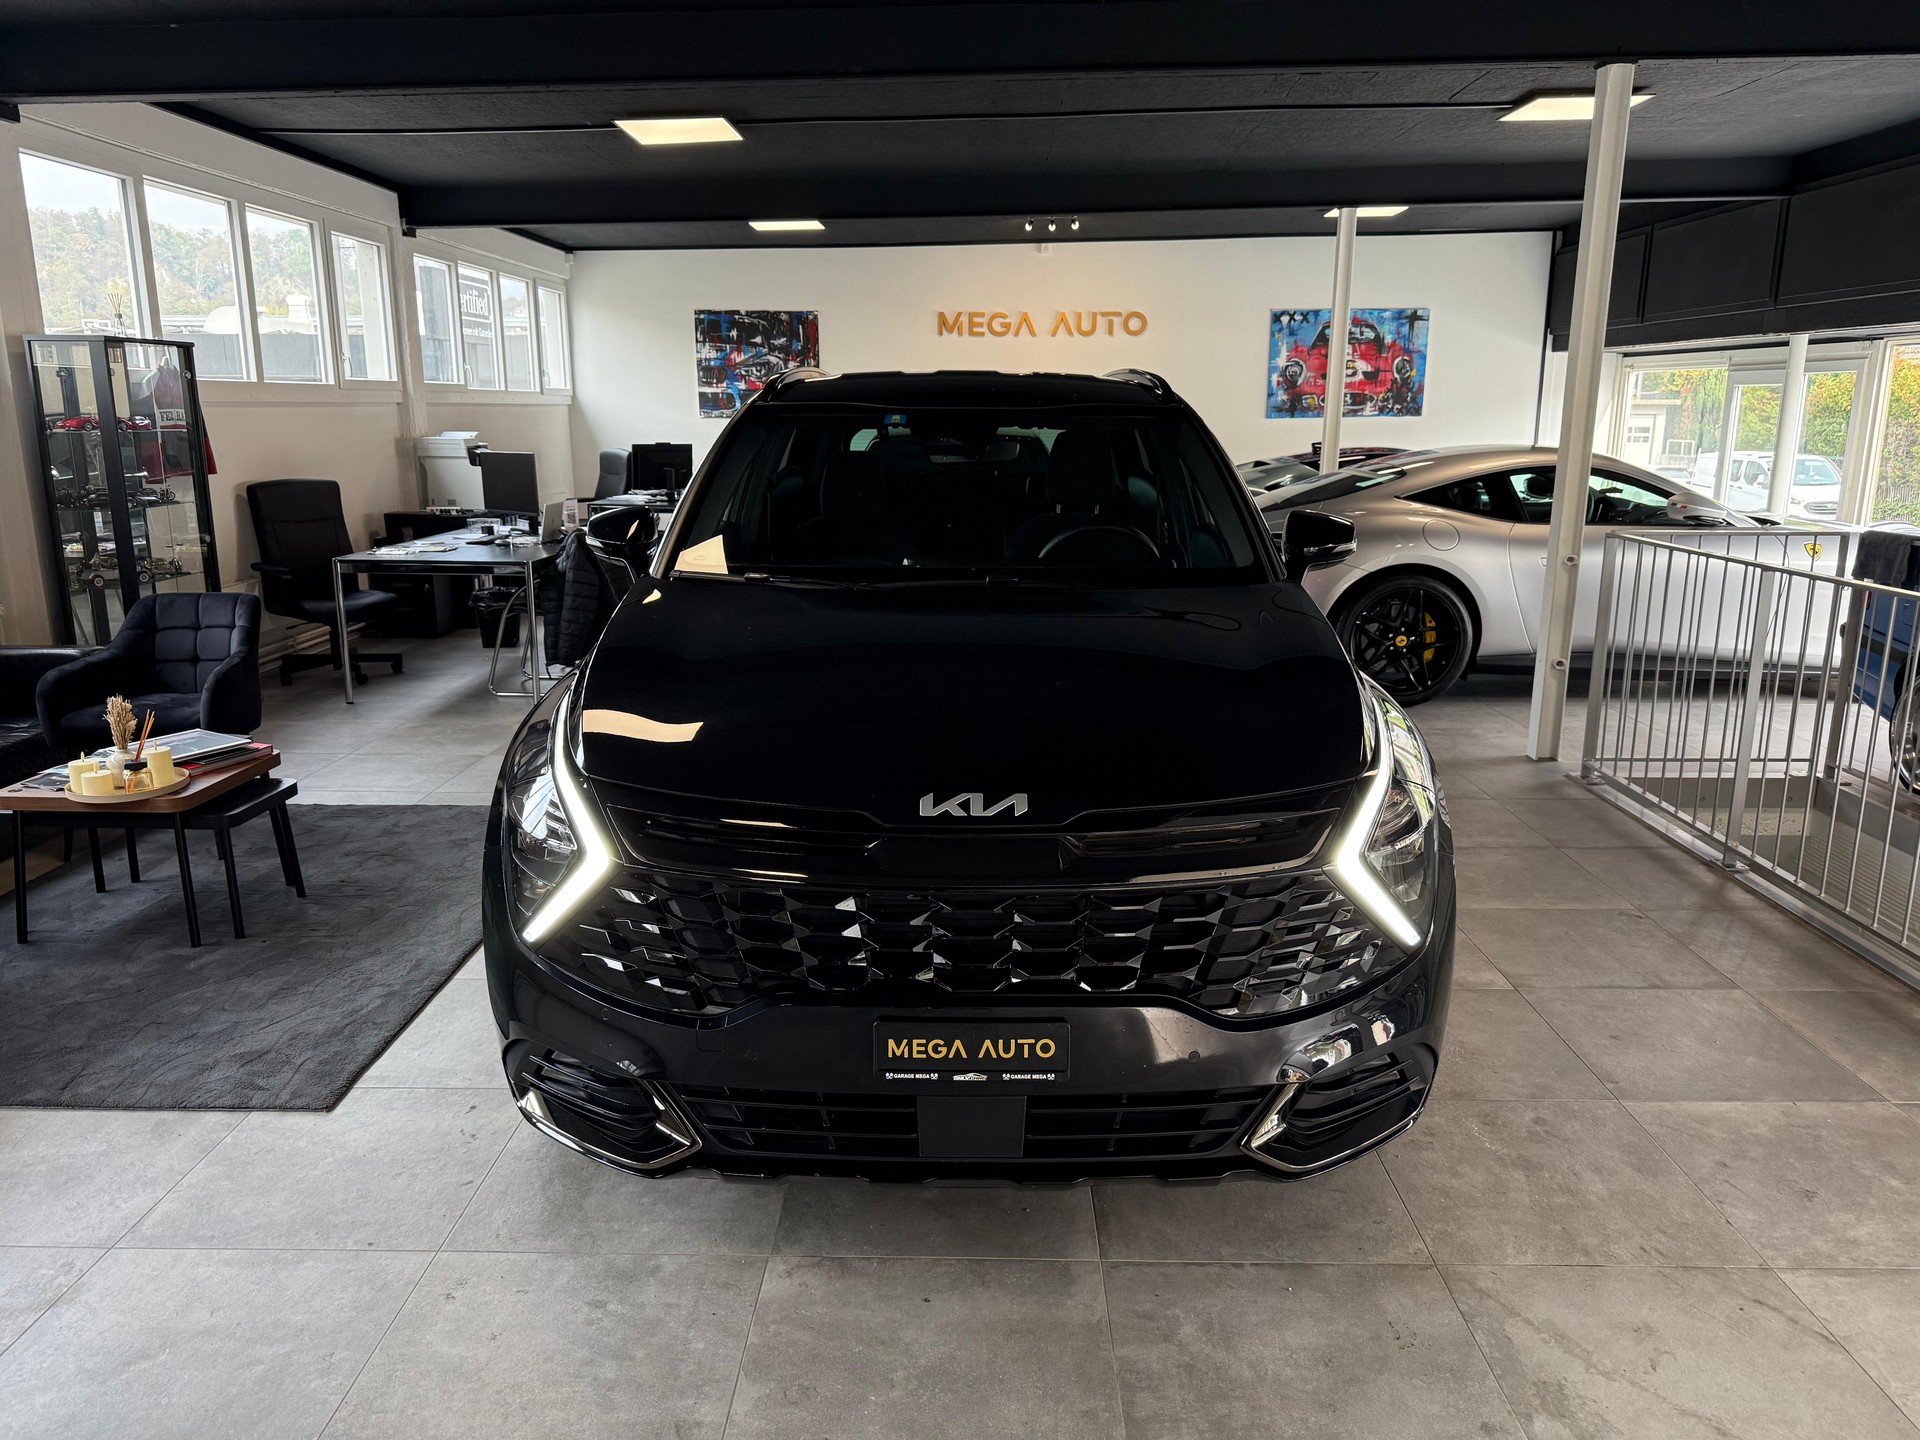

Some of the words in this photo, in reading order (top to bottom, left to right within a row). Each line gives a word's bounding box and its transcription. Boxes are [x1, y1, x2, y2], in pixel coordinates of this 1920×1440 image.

[937, 311, 1037, 337] MEGA
[1050, 311, 1148, 337] AUTO
[920, 792, 1028, 817] KIA
[887, 1038, 968, 1059] MEGA
[977, 1038, 1056, 1059] AUTO
